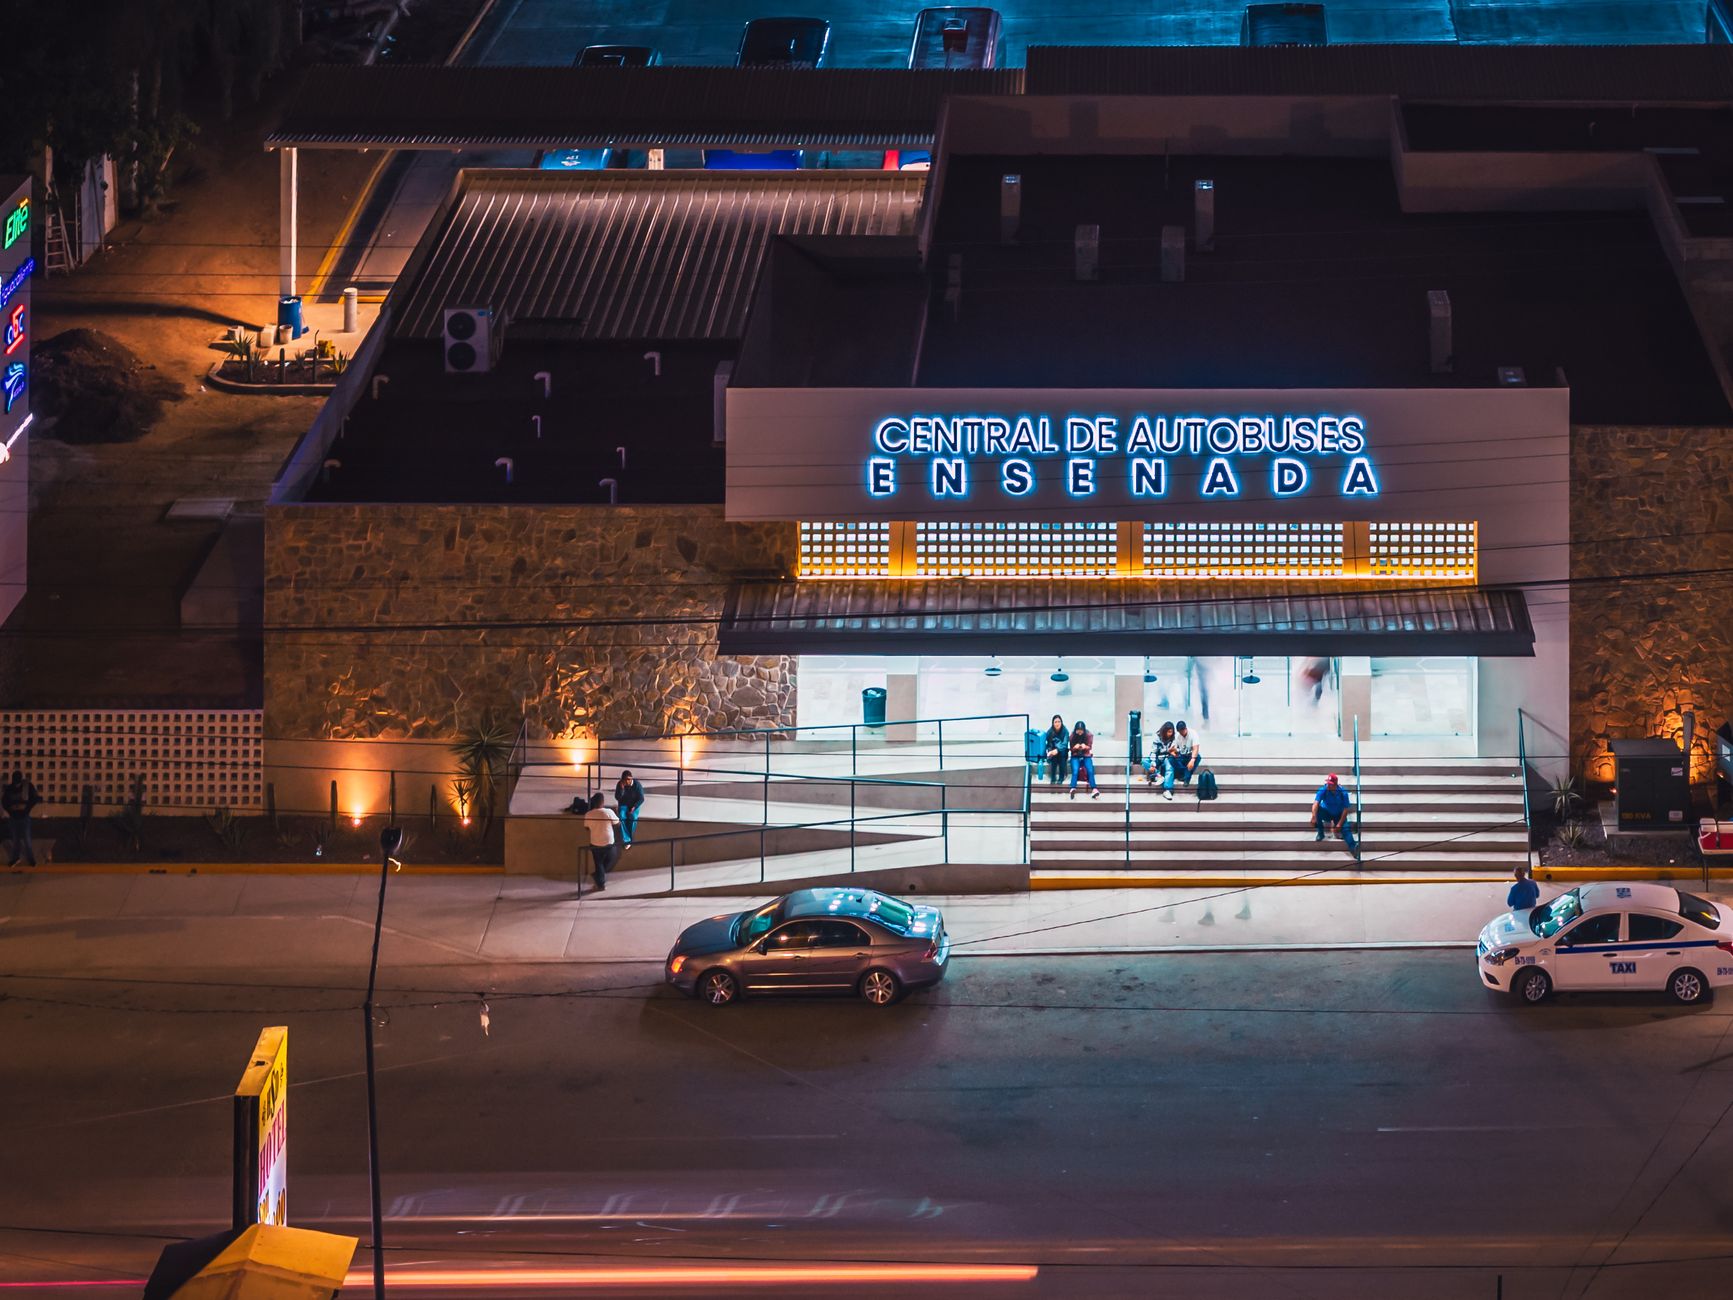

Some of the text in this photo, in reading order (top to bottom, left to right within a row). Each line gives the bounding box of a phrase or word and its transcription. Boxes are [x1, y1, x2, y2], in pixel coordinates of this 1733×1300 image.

[876, 417, 1365, 453] CENTRAL DE AUTOBUSES
[869, 457, 1378, 495] ENSENADA
[1609, 962, 1637, 974] TAXI
[258, 1099, 286, 1199] HOTEL
